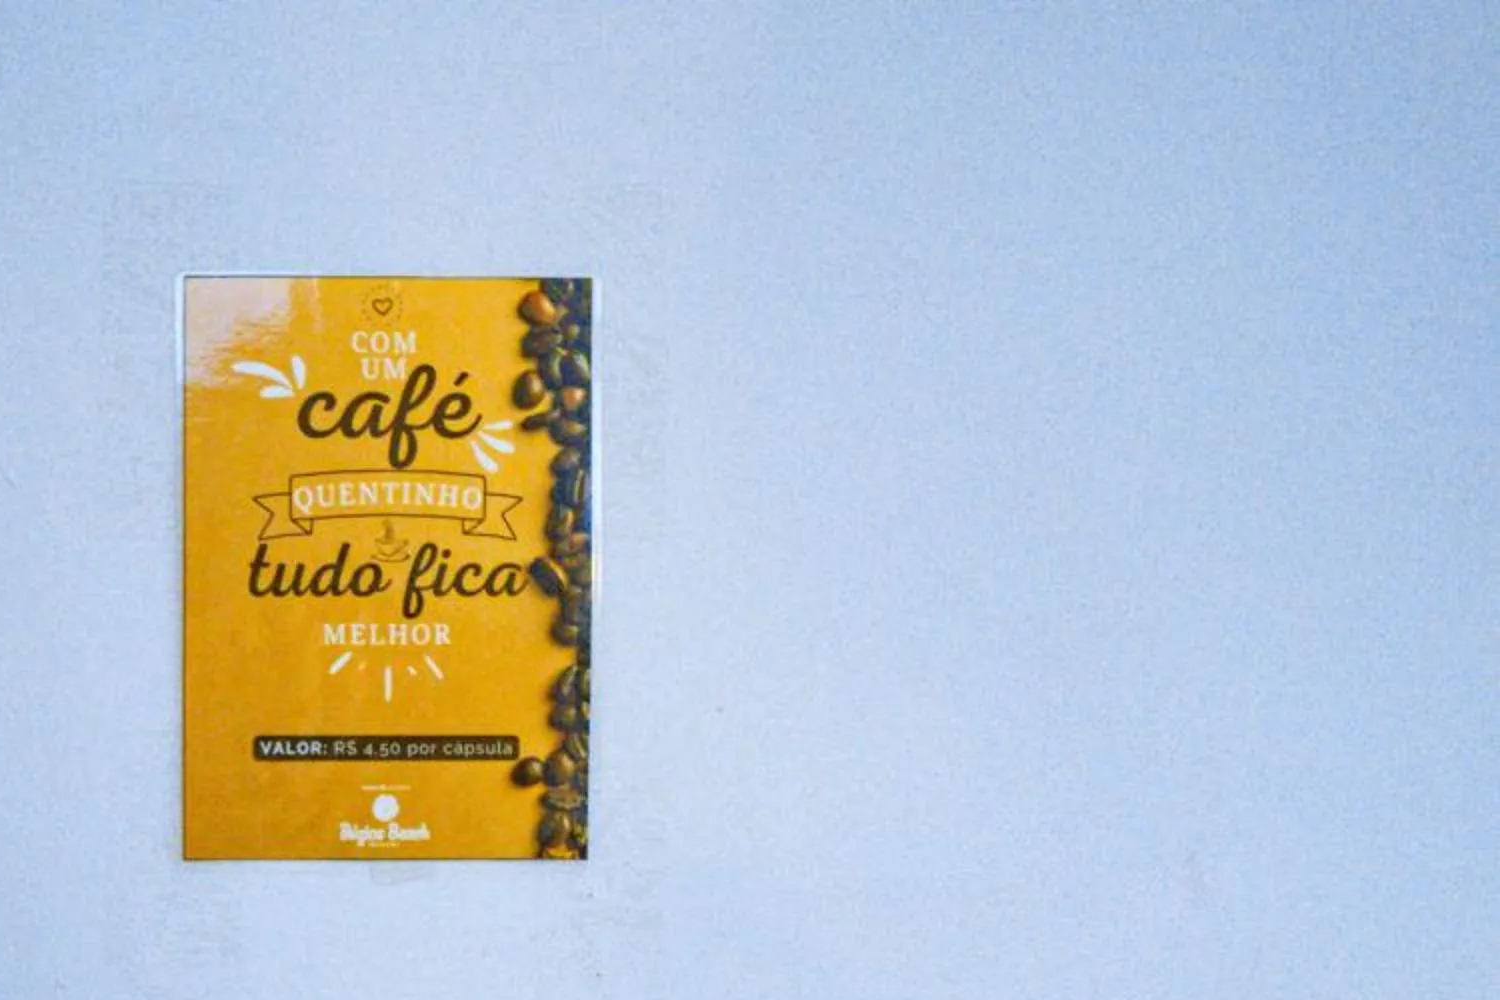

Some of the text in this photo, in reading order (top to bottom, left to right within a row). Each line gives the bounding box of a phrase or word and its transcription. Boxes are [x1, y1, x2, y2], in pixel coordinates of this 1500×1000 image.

[352, 331, 417, 353] COM
[361, 357, 407, 381] UM
[297, 364, 483, 469] café
[292, 481, 483, 514] QUENTINHO
[249, 542, 529, 619] tudo fica
[323, 623, 451, 646] MELHOR
[259, 740, 328, 756] VALOR:
[407, 743, 437, 758] por
